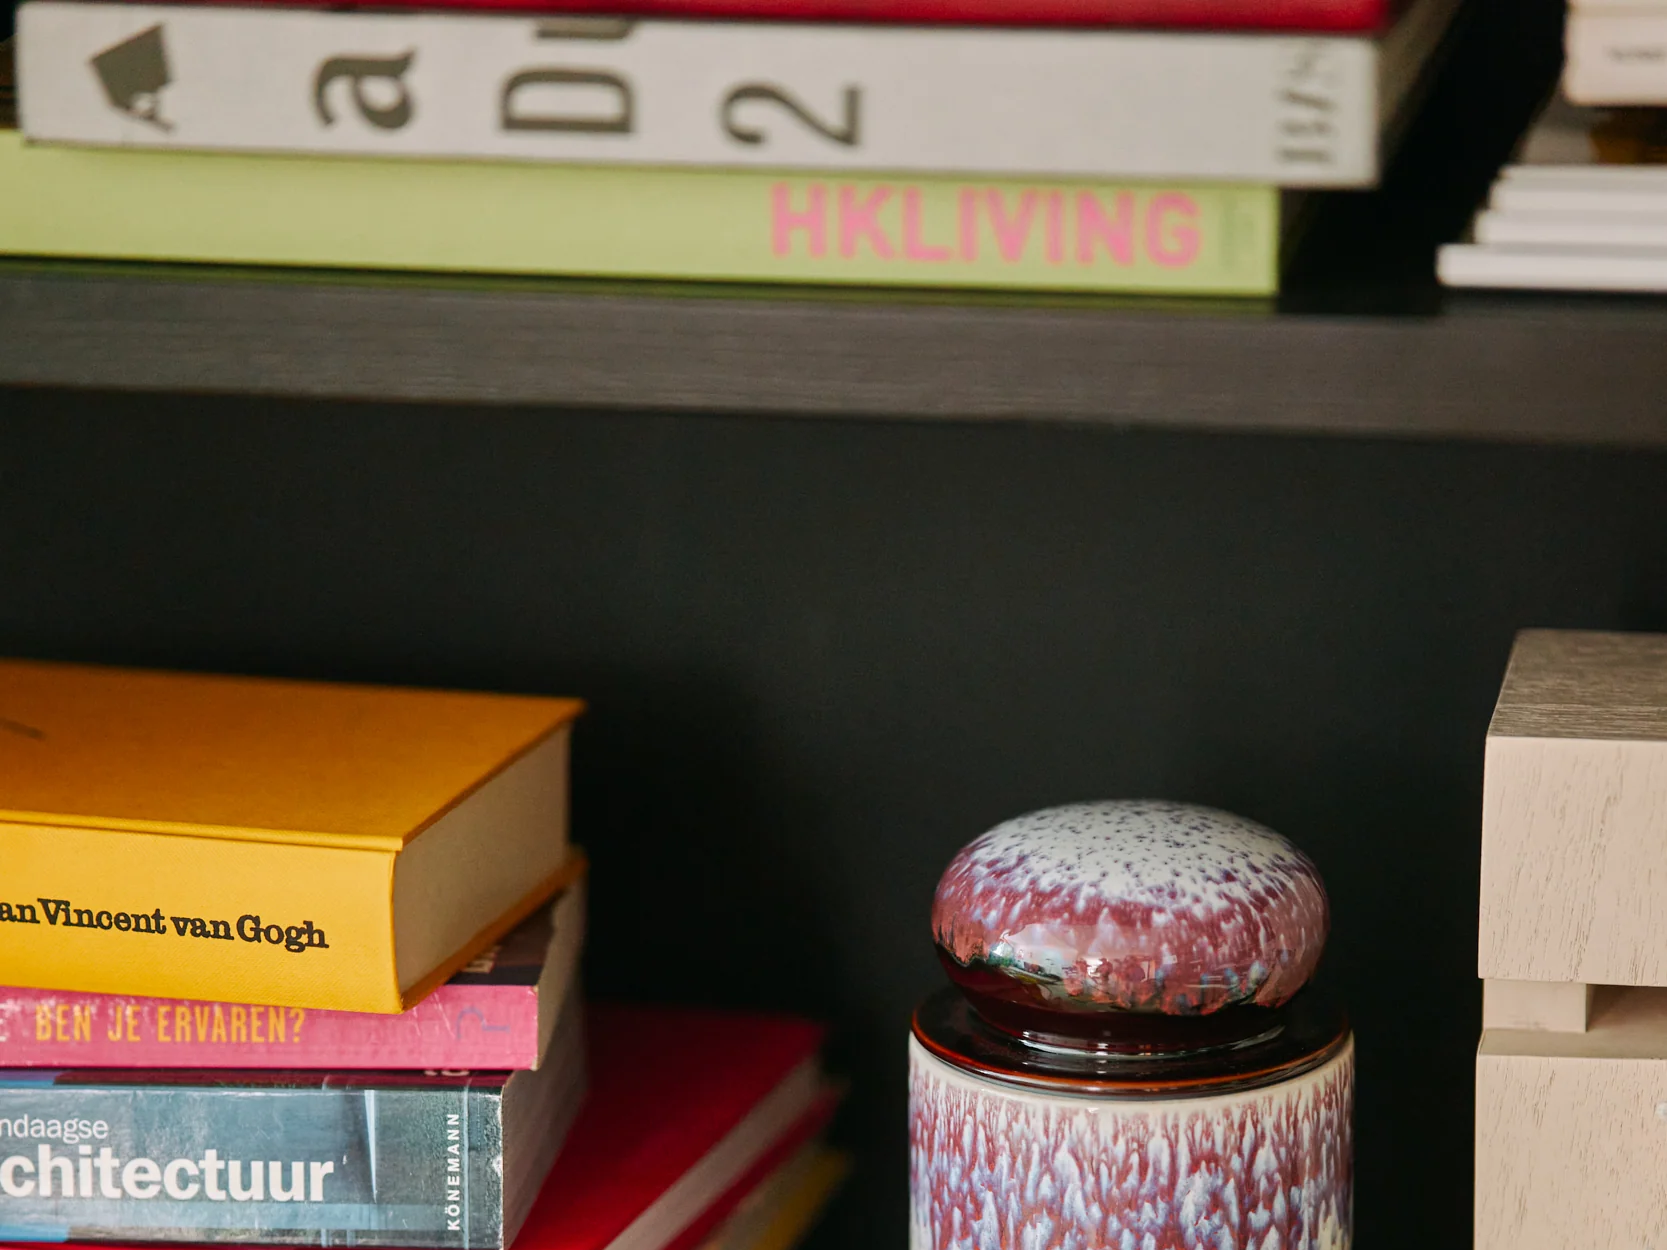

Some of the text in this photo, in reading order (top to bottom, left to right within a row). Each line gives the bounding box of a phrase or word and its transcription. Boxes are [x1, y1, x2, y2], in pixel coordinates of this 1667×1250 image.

[721, 80, 861, 146] 2
[772, 181, 1201, 268] HKLIVING
[37, 897, 167, 934] Vincent
[171, 915, 234, 940] van
[236, 914, 330, 952] Gogh
[35, 1003, 91, 1042] BEN
[108, 1004, 141, 1042] JE
[157, 1005, 306, 1043] ERVAREN?
[0, 1143, 335, 1202] chitectuur
[444, 1113, 461, 1231] KÖNEMANN
